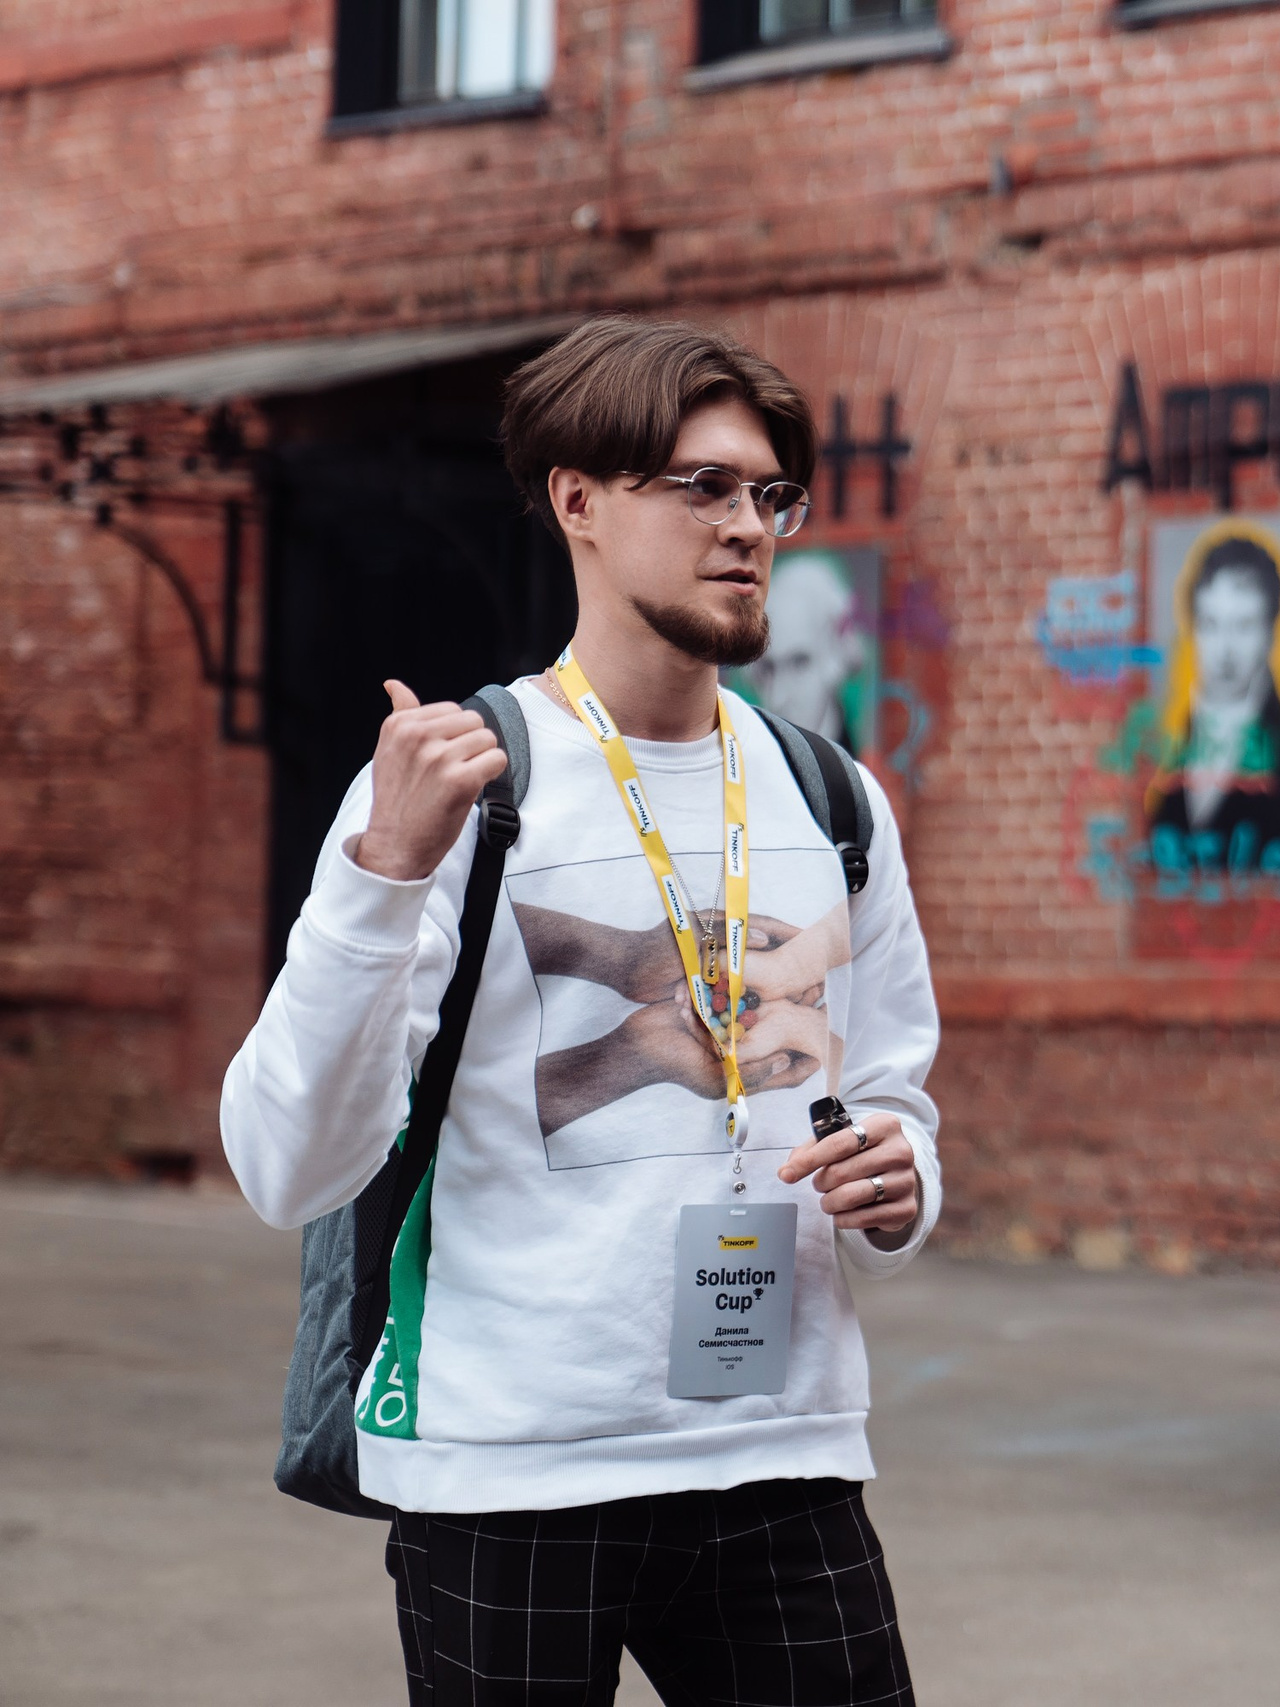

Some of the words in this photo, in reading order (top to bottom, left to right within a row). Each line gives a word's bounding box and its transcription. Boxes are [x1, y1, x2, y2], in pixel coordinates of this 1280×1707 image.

[584, 699, 611, 736] TINKOFF
[628, 784, 650, 828] TINKOFF
[731, 829, 739, 872] TINKOFF
[666, 880, 684, 926] TINKOFF
[730, 925, 738, 969] TINKOFF
[695, 1268, 776, 1287] Solution
[715, 1293, 753, 1313] Cup
[698, 1338, 764, 1348] Семисчастнов
[715, 1327, 749, 1337] Данила
